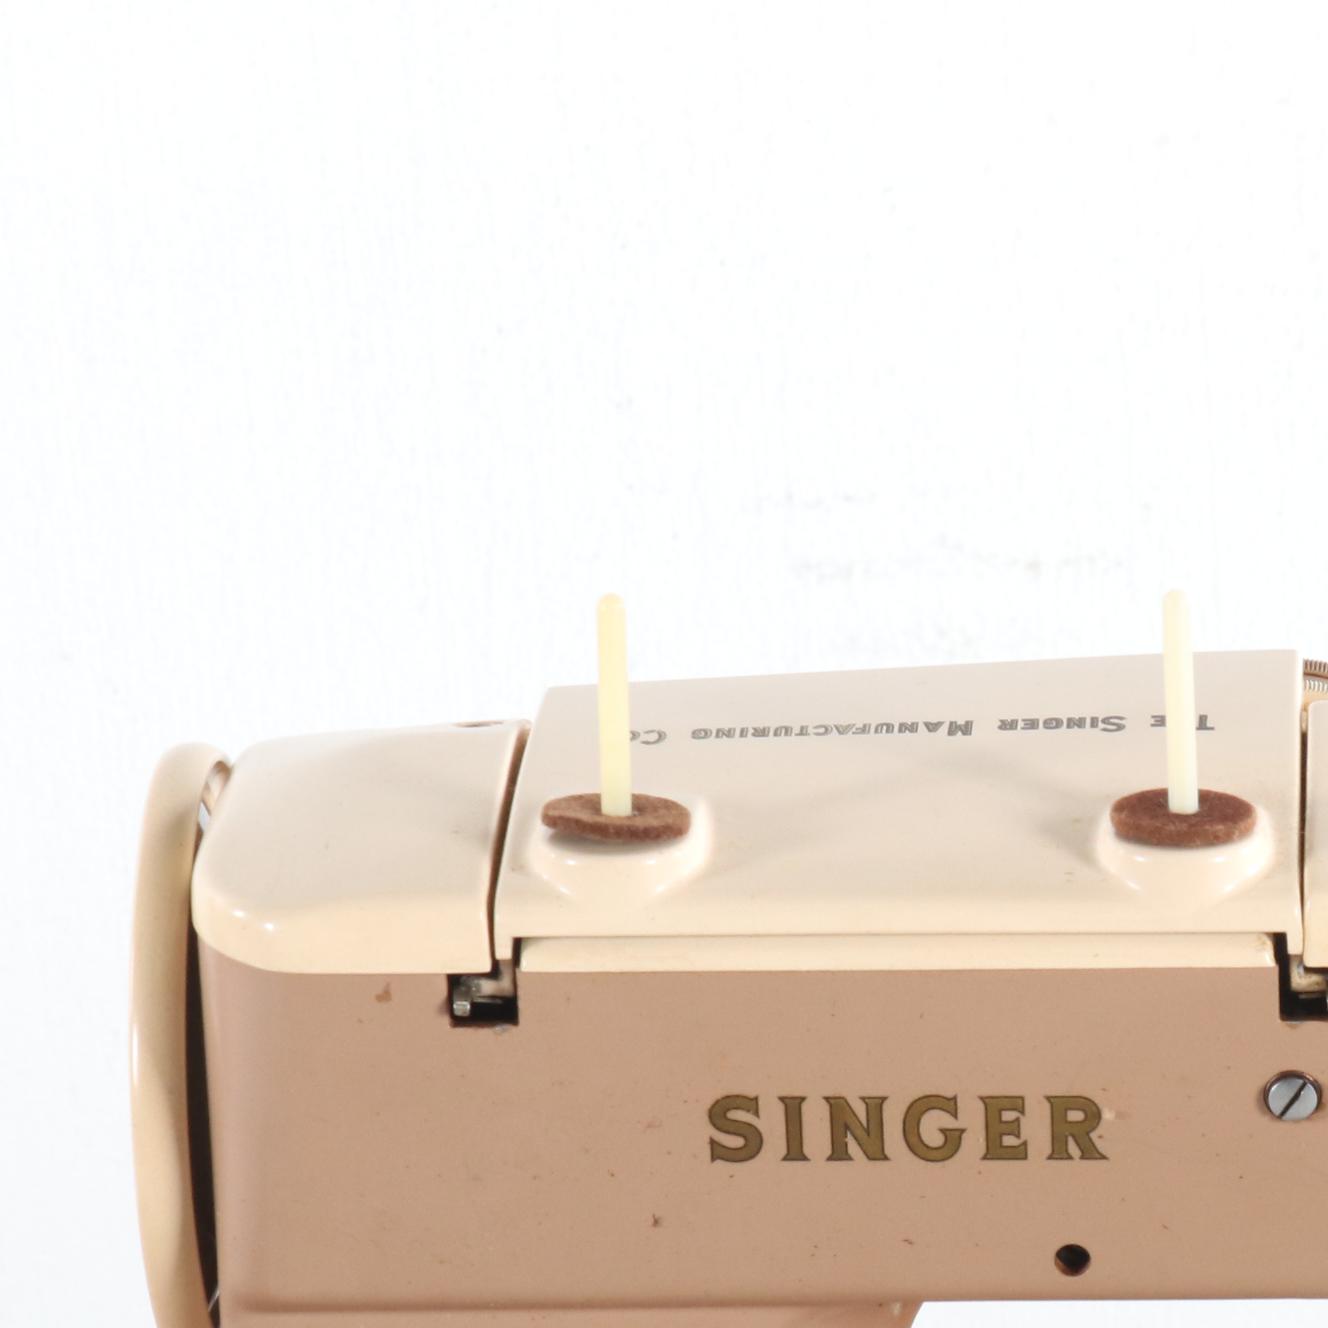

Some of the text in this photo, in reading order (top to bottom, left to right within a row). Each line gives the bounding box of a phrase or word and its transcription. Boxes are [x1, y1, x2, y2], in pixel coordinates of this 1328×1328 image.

[690, 719, 974, 741] MANUFACTURING
[996, 715, 1127, 733] SINGER
[1149, 713, 1216, 732] TE
[707, 1093, 1109, 1163] SINGER
